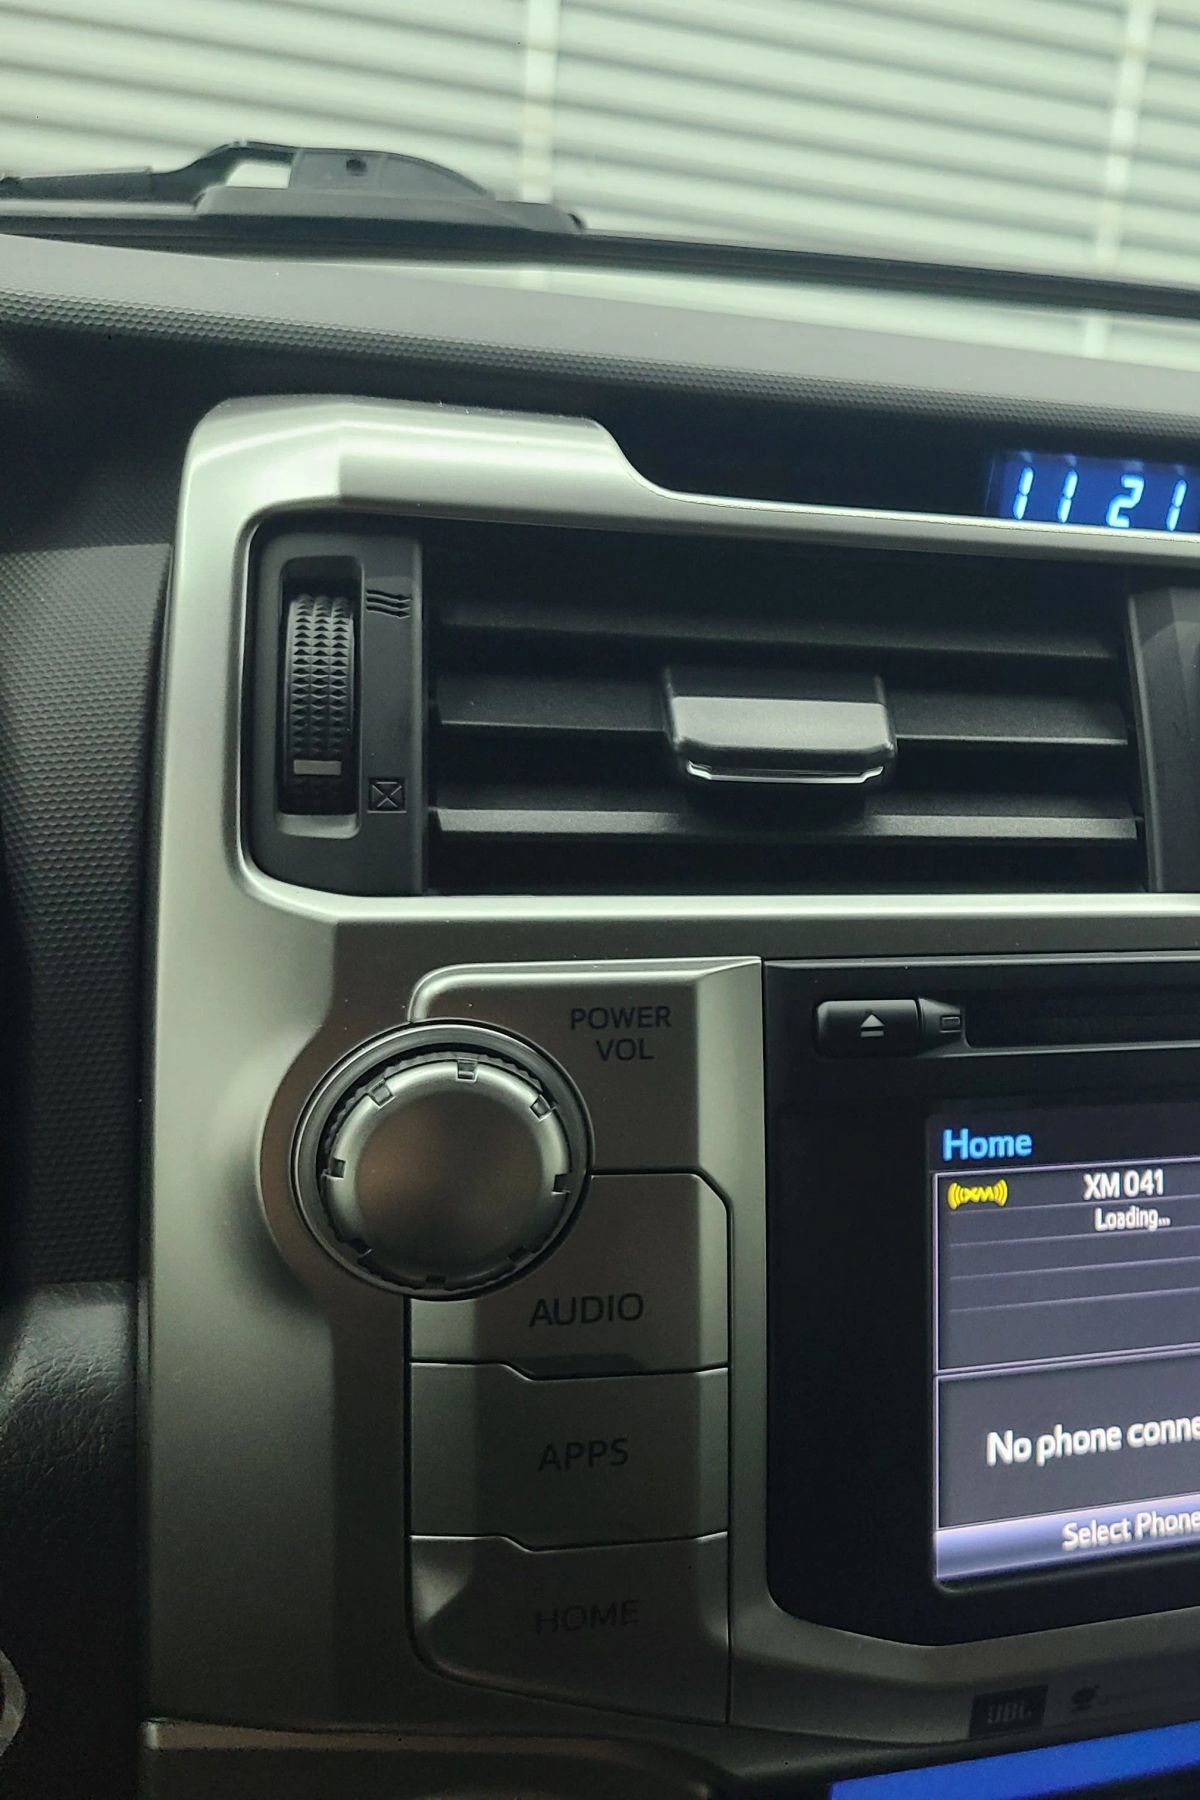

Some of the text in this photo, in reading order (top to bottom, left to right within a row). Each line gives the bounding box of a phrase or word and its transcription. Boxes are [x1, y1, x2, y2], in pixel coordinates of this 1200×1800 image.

[570, 1005, 672, 1031] POWER
[595, 1038, 655, 1061] VOL
[943, 1128, 1033, 1161] Home
[1083, 1170, 1165, 1200] XM 041
[1095, 1206, 1171, 1231] Loading...
[528, 1292, 645, 1327] AUDIO
[538, 1438, 629, 1471] APPS
[986, 1430, 1032, 1465] No
[1036, 1424, 1122, 1465] phone
[1062, 1521, 1132, 1551] Select
[535, 1599, 641, 1634] HOME
